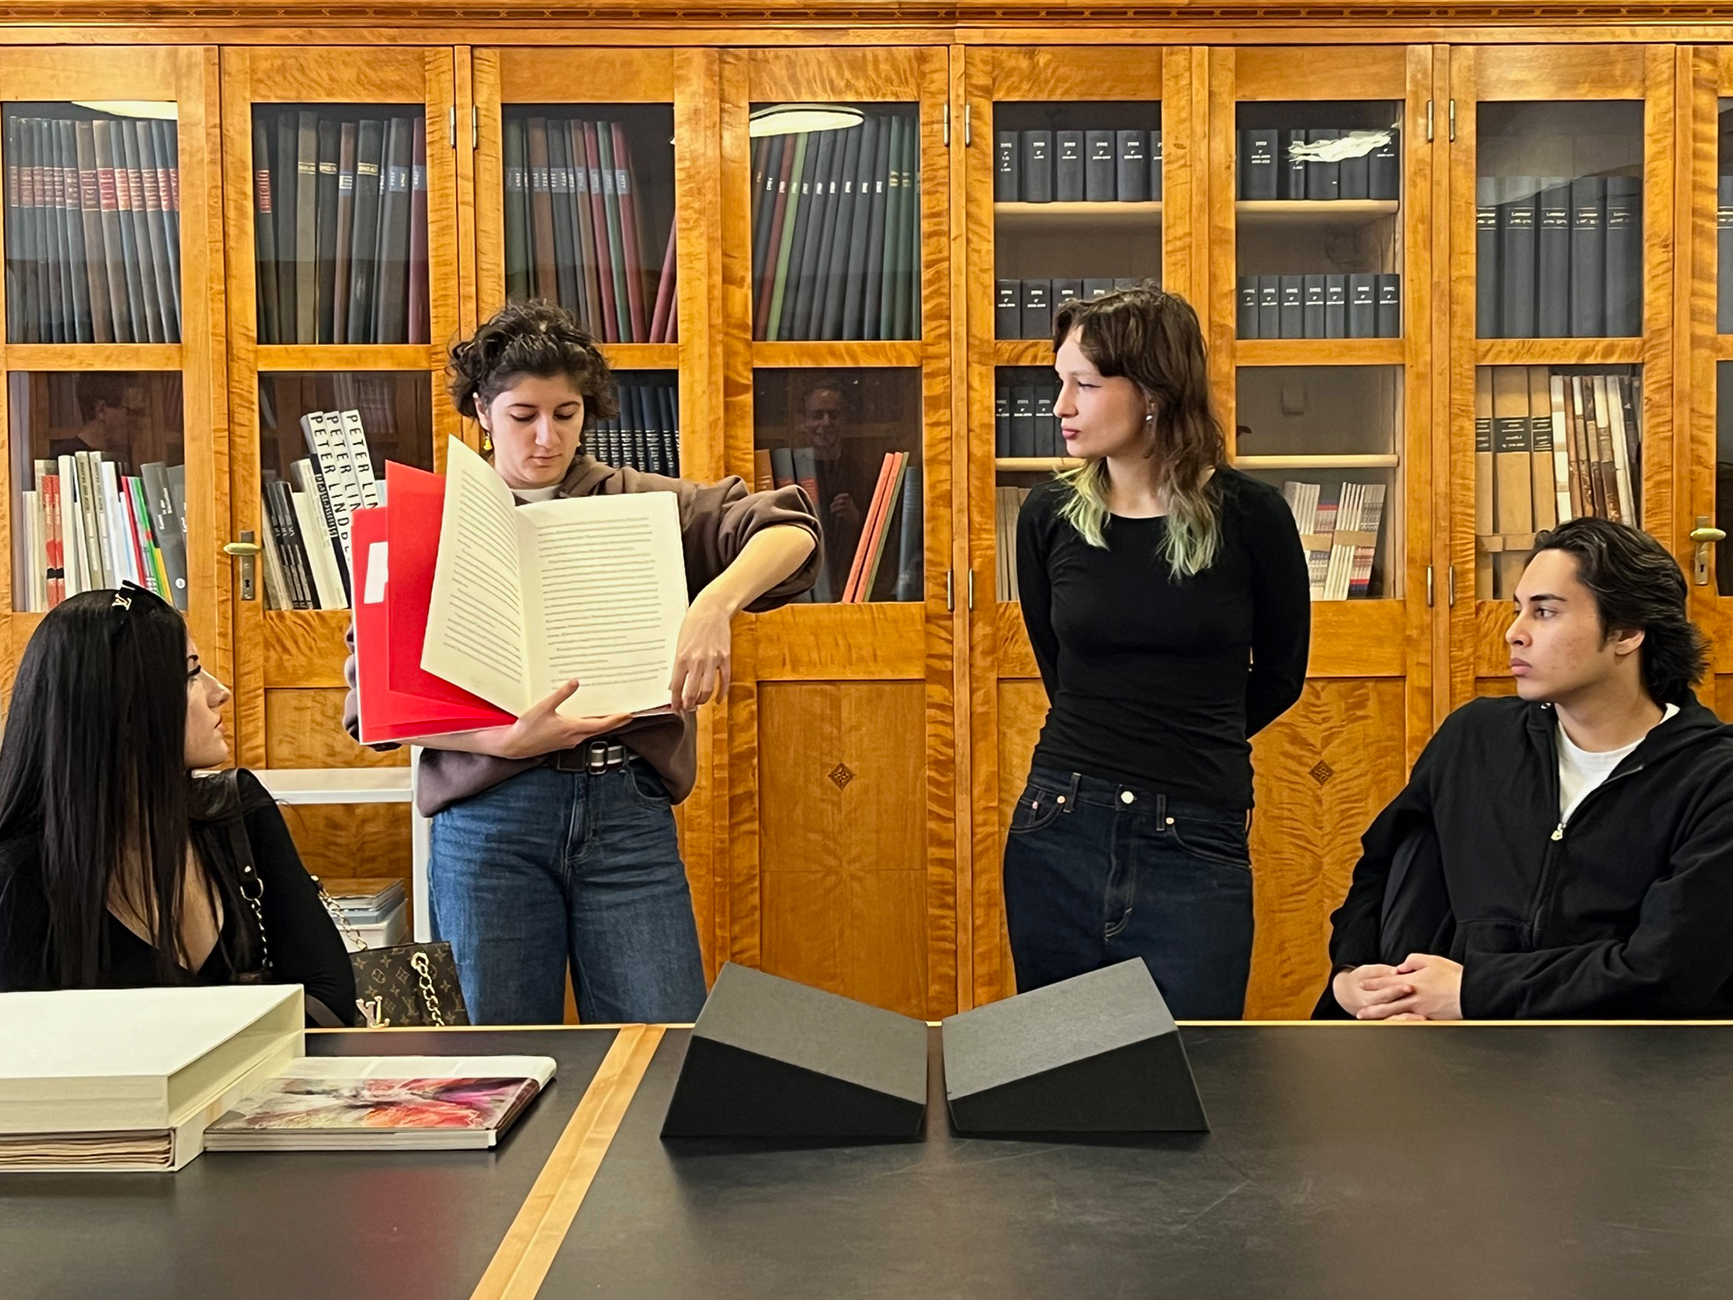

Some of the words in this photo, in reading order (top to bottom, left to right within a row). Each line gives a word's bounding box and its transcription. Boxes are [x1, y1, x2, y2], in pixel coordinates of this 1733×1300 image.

[310, 415, 336, 474] PETER
[326, 415, 352, 474] PETER
[346, 414, 370, 473] PETER
